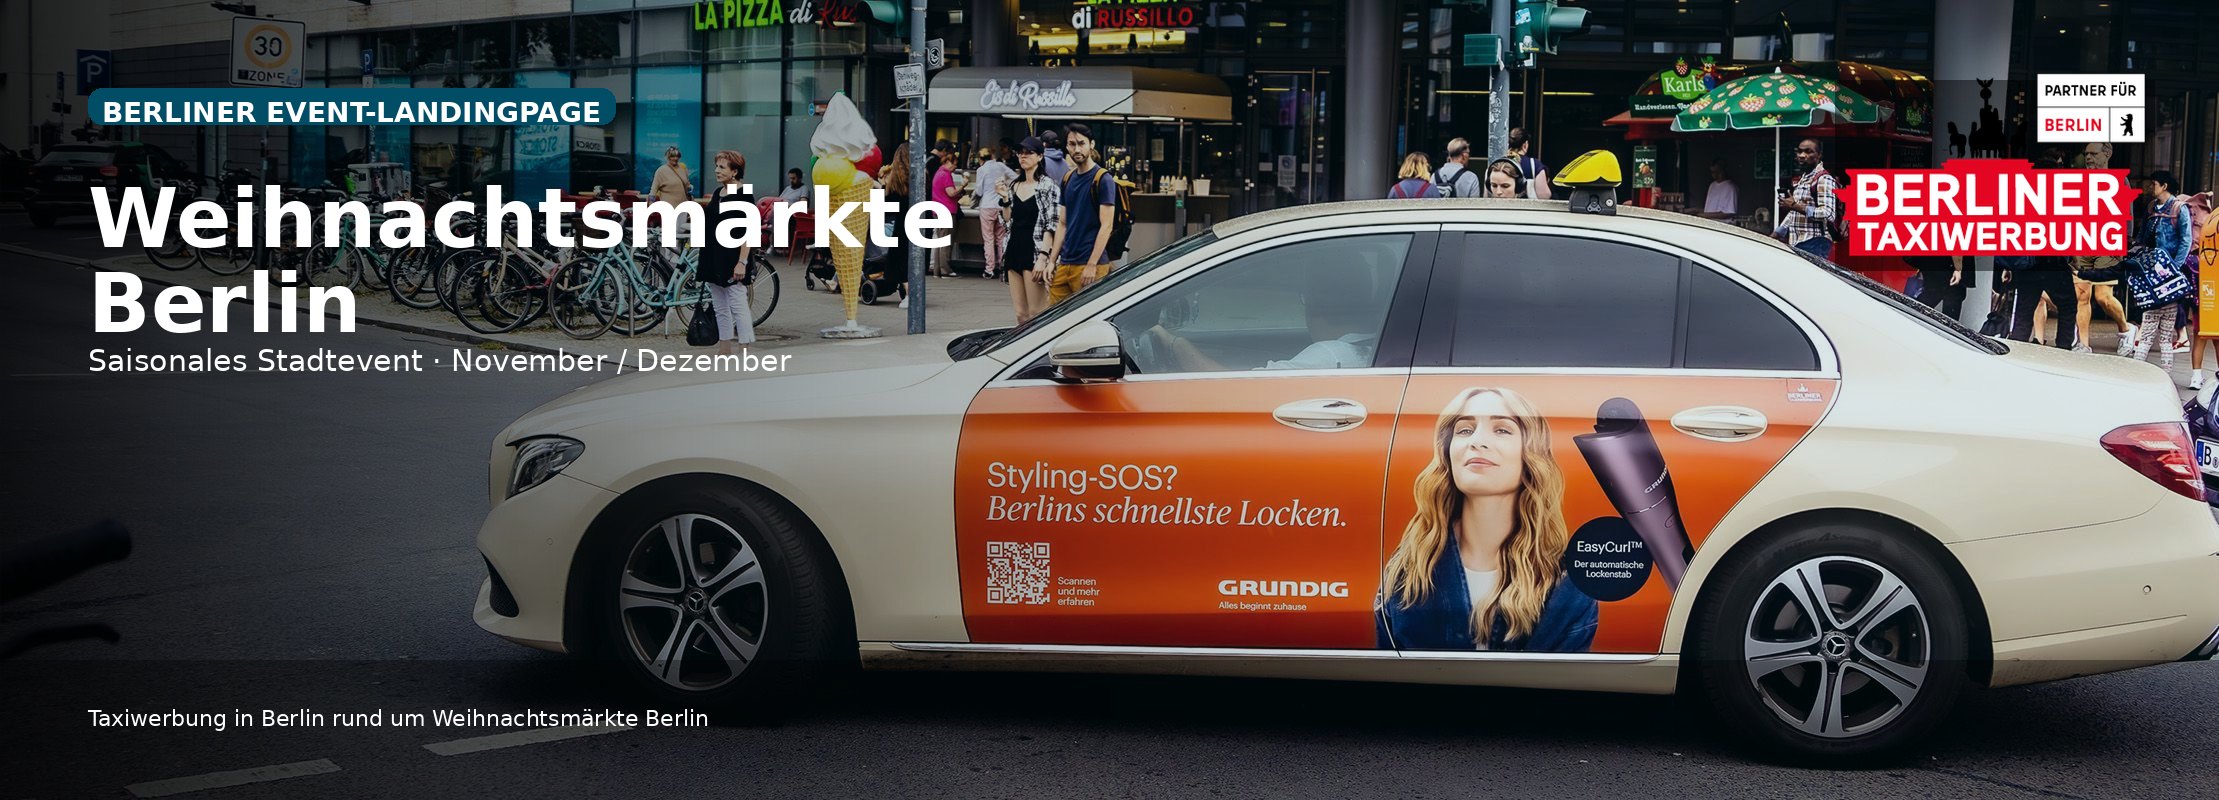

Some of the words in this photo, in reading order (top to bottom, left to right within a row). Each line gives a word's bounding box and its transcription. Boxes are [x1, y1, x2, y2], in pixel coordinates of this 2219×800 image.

[694, 2, 718, 30] LA
[723, 0, 784, 29] PIZZA
[790, 0, 813, 24] di
[1072, 6, 1092, 29] di
[1097, 7, 1193, 28] RUSSILLO
[254, 36, 283, 57] 30
[1664, 75, 1706, 93] Karls
[980, 78, 1003, 109] Eis
[1002, 80, 1018, 106] di
[1018, 80, 1077, 110] Russillo
[986, 461, 1178, 494] Styling-SOS?
[986, 494, 1086, 523] Berlins
[1092, 496, 1232, 526] schnellste
[1238, 499, 1347, 527] Locken.
[1574, 560, 1588, 568] Der
[1590, 560, 1644, 569] automatische
[1058, 576, 1097, 586] Scannen
[1586, 569, 1632, 579] Lockenstab
[1058, 587, 1076, 596] und
[1078, 587, 1100, 597] mehr
[1218, 579, 1349, 598] GRUNDIG
[1058, 597, 1095, 607] erfahren
[1218, 601, 1238, 610] Alles
[1240, 602, 1271, 612] beginnt
[1273, 603, 1307, 611] zuhause
